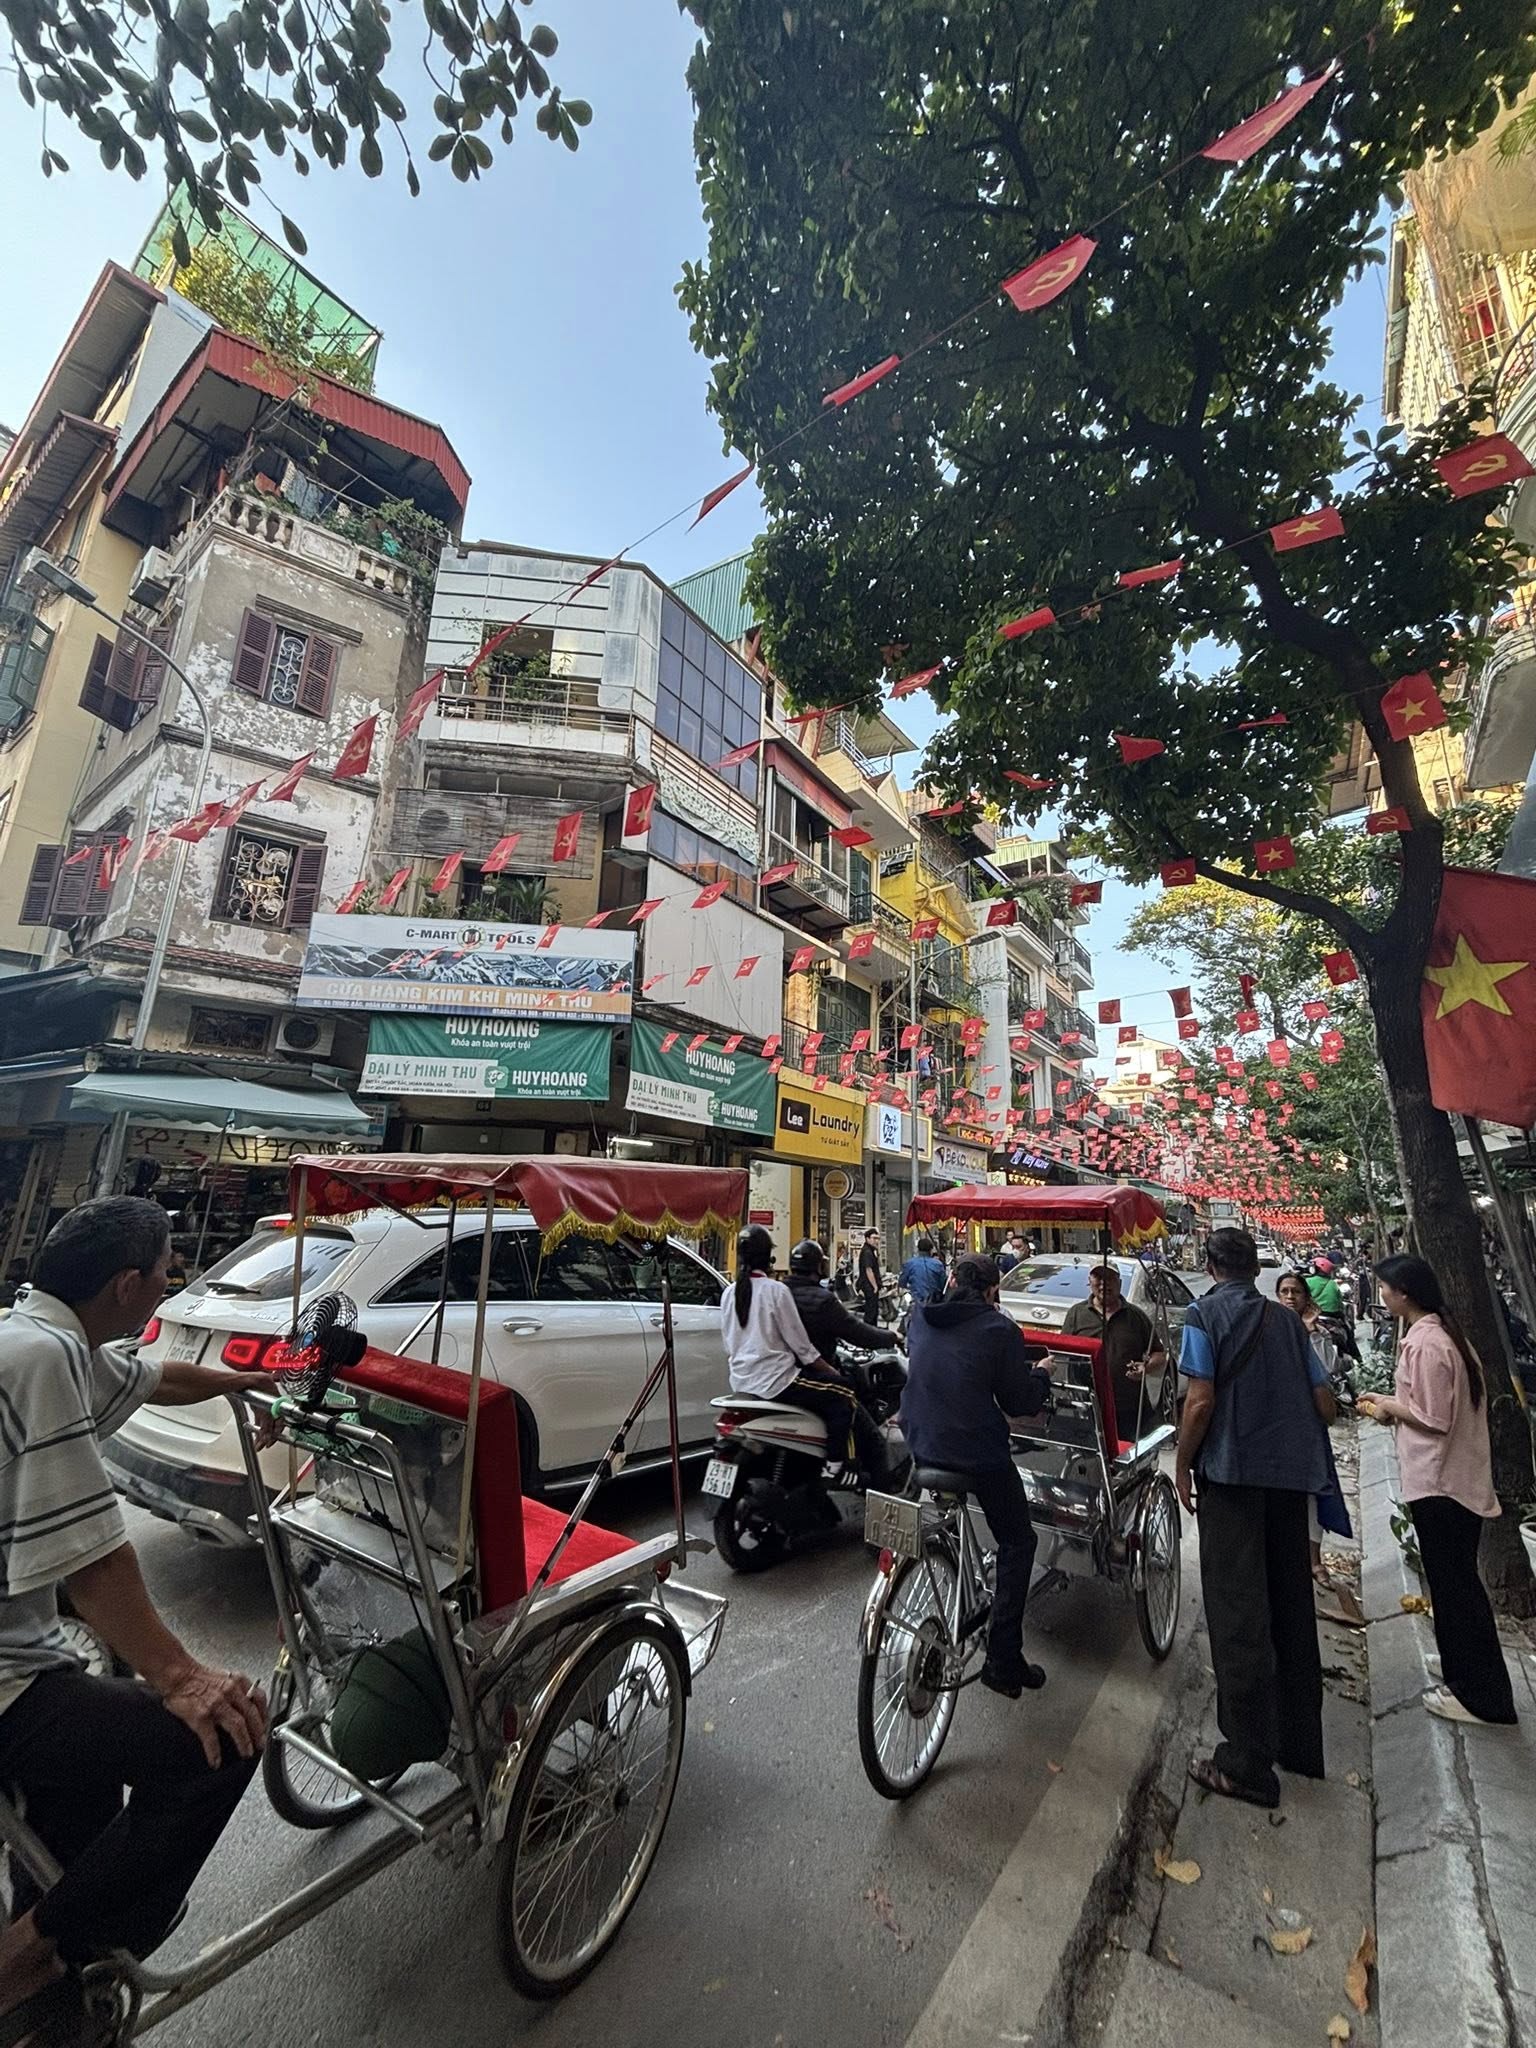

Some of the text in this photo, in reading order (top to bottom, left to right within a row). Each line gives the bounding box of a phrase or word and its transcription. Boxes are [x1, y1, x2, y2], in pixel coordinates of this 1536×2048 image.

[406, 928, 537, 945] C-MART TOOLS
[327, 979, 363, 996] CỬA
[369, 983, 421, 999] HÀNG
[428, 988, 463, 1001] KIM
[469, 989, 500, 1004] KHÍ
[559, 994, 592, 1008] THU
[451, 1038, 470, 1047] Khóa
[482, 1039, 498, 1048] toàn
[500, 1041, 516, 1050] vượt
[518, 1041, 531, 1051] trội
[367, 1061, 478, 1079] ĐẠI LÝ MINH THU
[517, 1087, 532, 1095] Khóa
[632, 1079, 646, 1095] ĐẠI
[649, 1081, 659, 1095] LÝ
[661, 1086, 680, 1101] MINH
[683, 1090, 697, 1104] THU
[787, 1106, 803, 1126] Lee
[812, 1107, 860, 1139] Laundry
